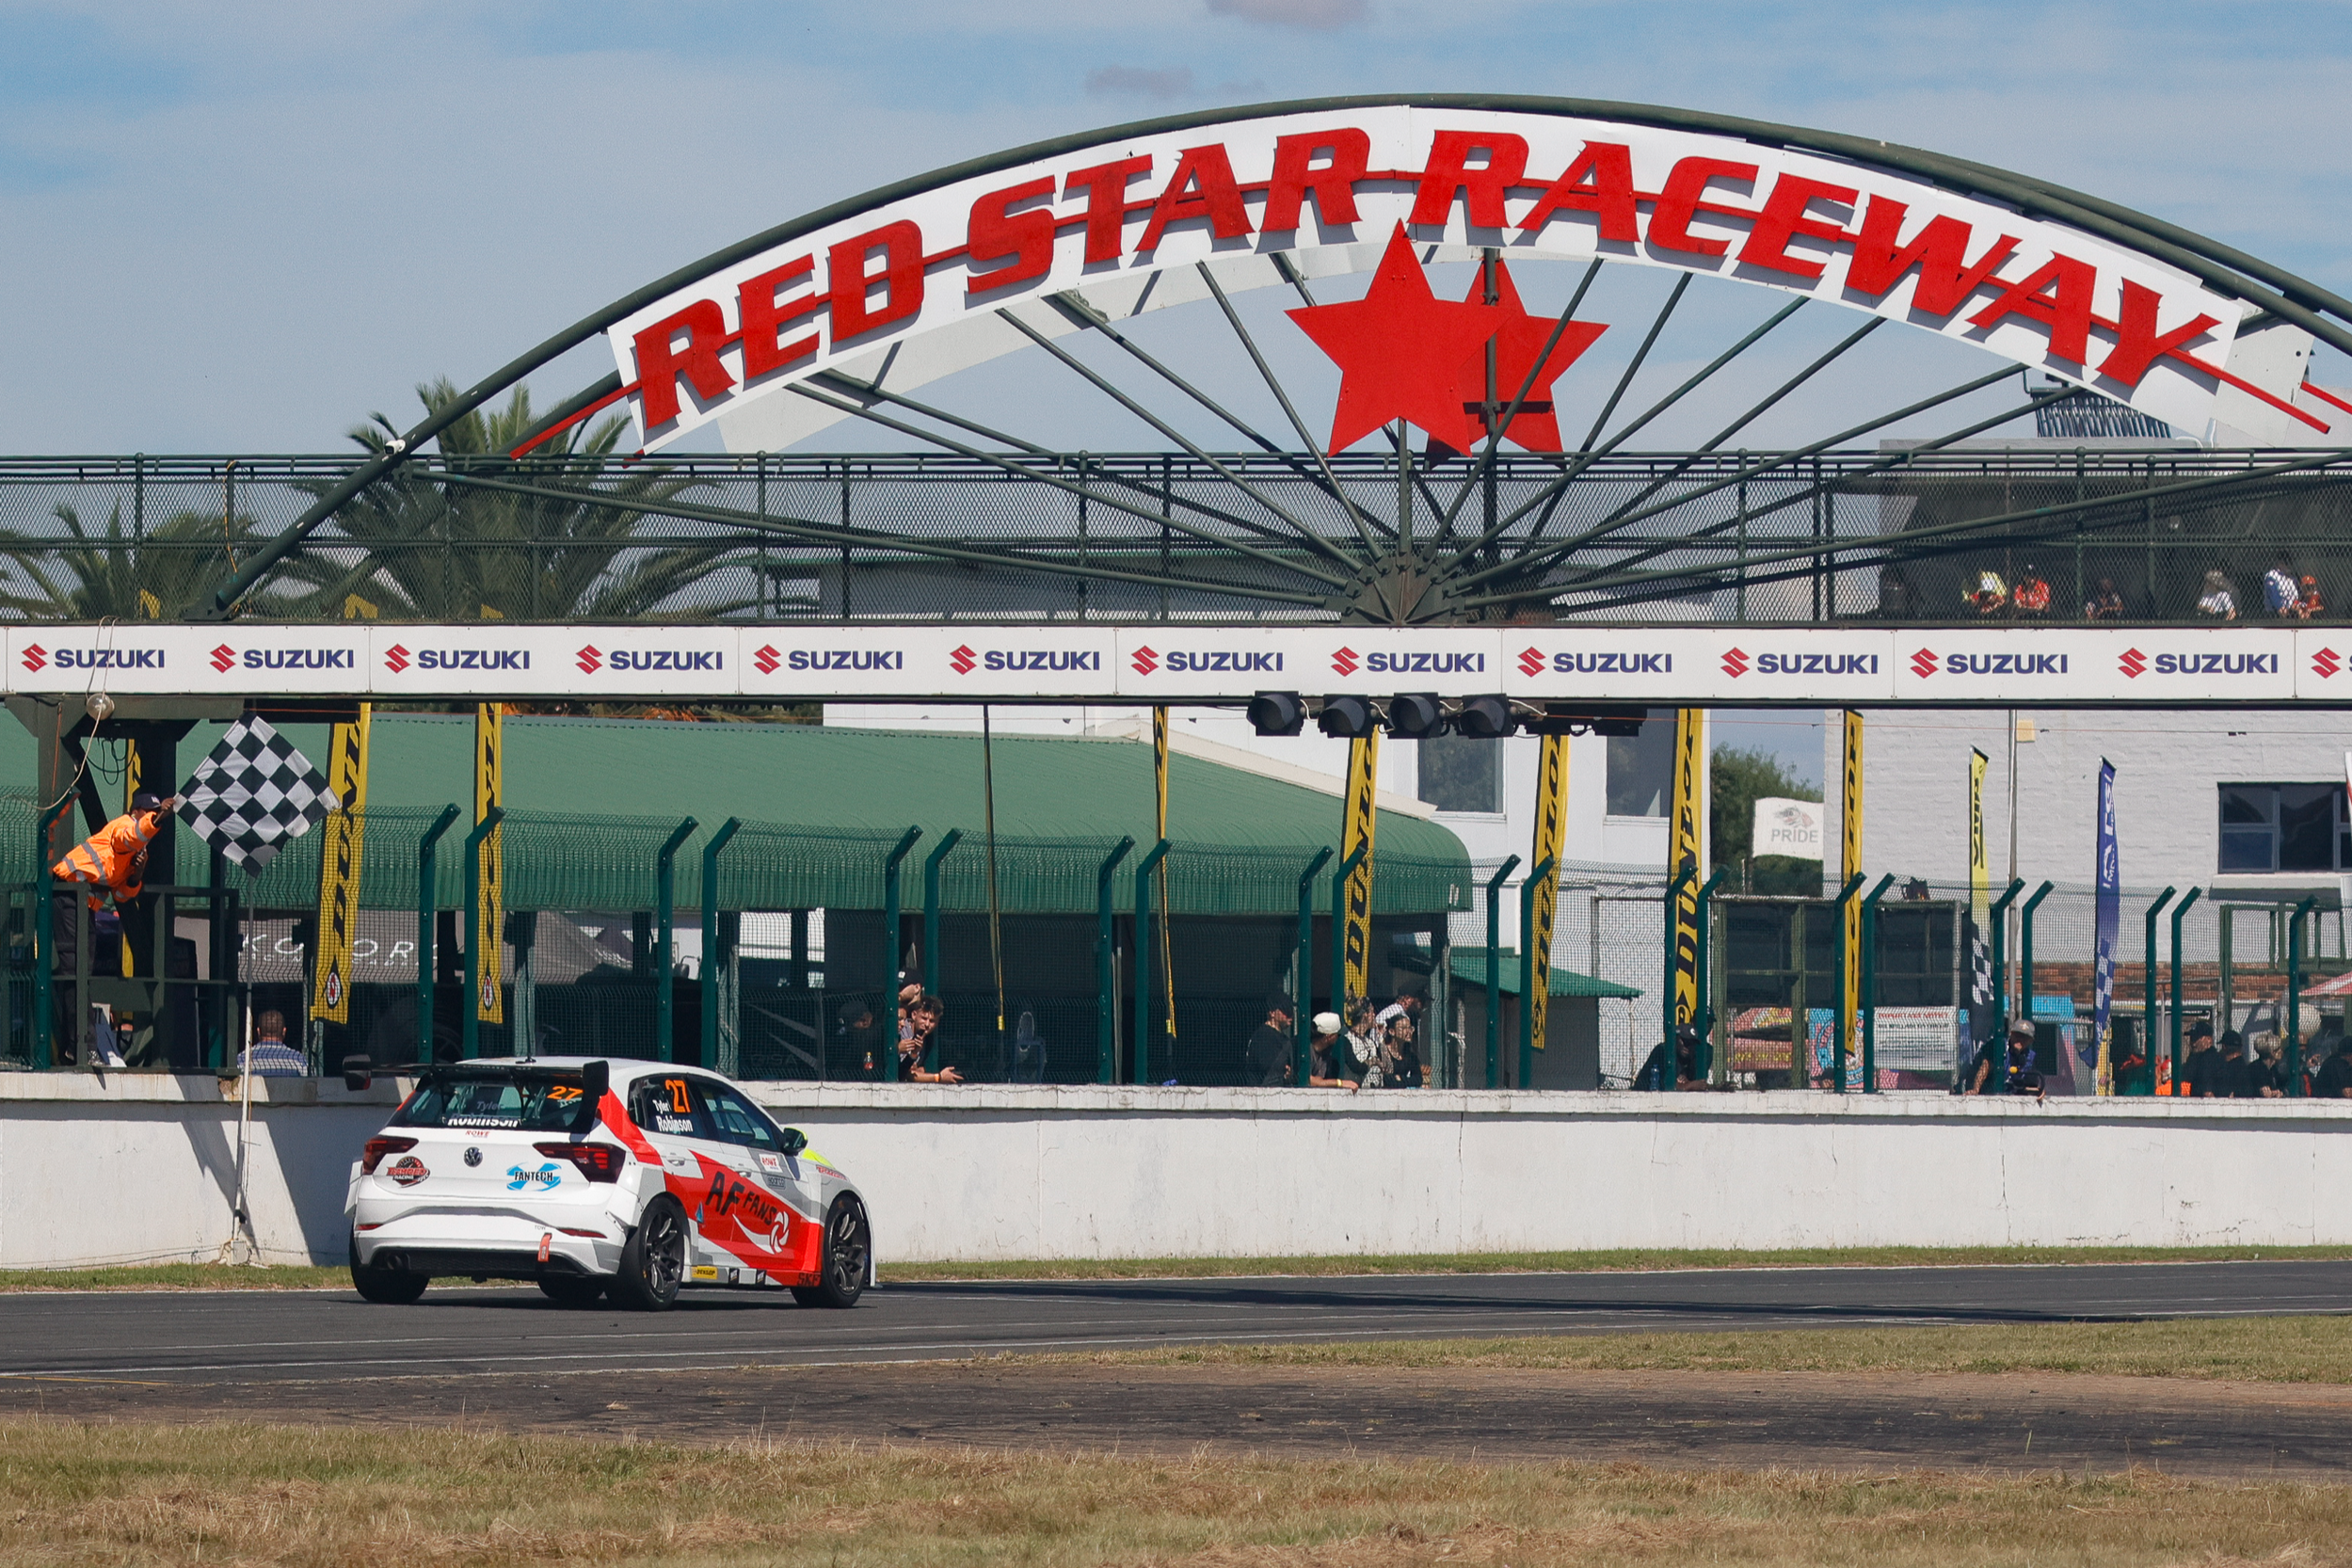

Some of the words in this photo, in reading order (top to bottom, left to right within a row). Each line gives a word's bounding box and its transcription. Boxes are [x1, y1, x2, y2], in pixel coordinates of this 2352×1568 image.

[632, 218, 925, 429] RED
[967, 126, 1371, 294] STAR
[1409, 129, 2220, 387] RACEWAY
[56, 648, 165, 668] SUZUKI
[244, 649, 354, 669] SUZUKI
[419, 649, 530, 670] SUZUKI
[610, 650, 723, 671] SUZUKI
[790, 650, 903, 670] SUZUKI
[985, 650, 1100, 670] SUZUKI
[1167, 651, 1284, 672] SUZUKI
[1368, 652, 1485, 673] SUZUKI
[1554, 652, 1672, 673] SUZUKI
[1758, 653, 1879, 674] SUZUKI
[1947, 654, 2068, 674] SUZUKI
[2156, 654, 2278, 674] SUZUKI
[1770, 828, 1819, 843] PRIDE
[547, 1085, 584, 1101] 27
[664, 1079, 692, 1113] 27
[652, 1098, 671, 1114] Tyler
[448, 1112, 519, 1128] Robinson
[655, 1115, 694, 1132] Robinson
[761, 1157, 777, 1167] ROWE
[515, 1171, 553, 1182] FANTECH
[705, 1171, 745, 1216] AF
[743, 1191, 778, 1226] FANS
[797, 1272, 822, 1287] SKF
